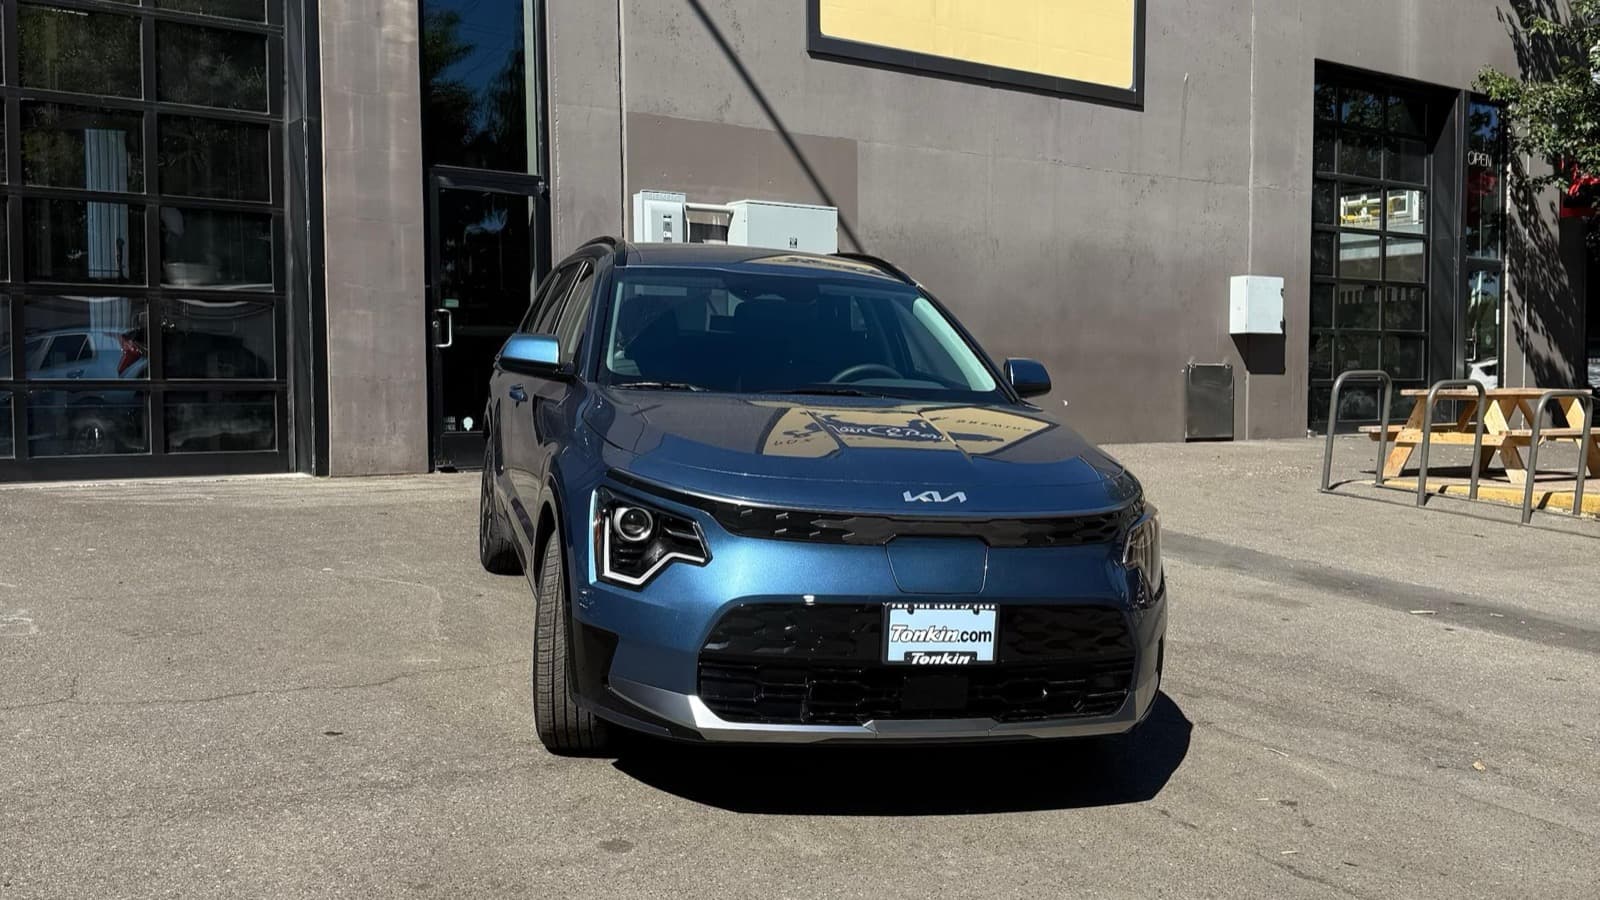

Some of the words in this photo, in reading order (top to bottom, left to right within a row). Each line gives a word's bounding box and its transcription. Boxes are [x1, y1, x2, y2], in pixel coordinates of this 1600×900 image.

[1467, 150, 1492, 167] OPEN
[903, 489, 967, 503] KIA
[891, 624, 992, 643] Tonkin.com
[911, 652, 970, 665] Tonkin
